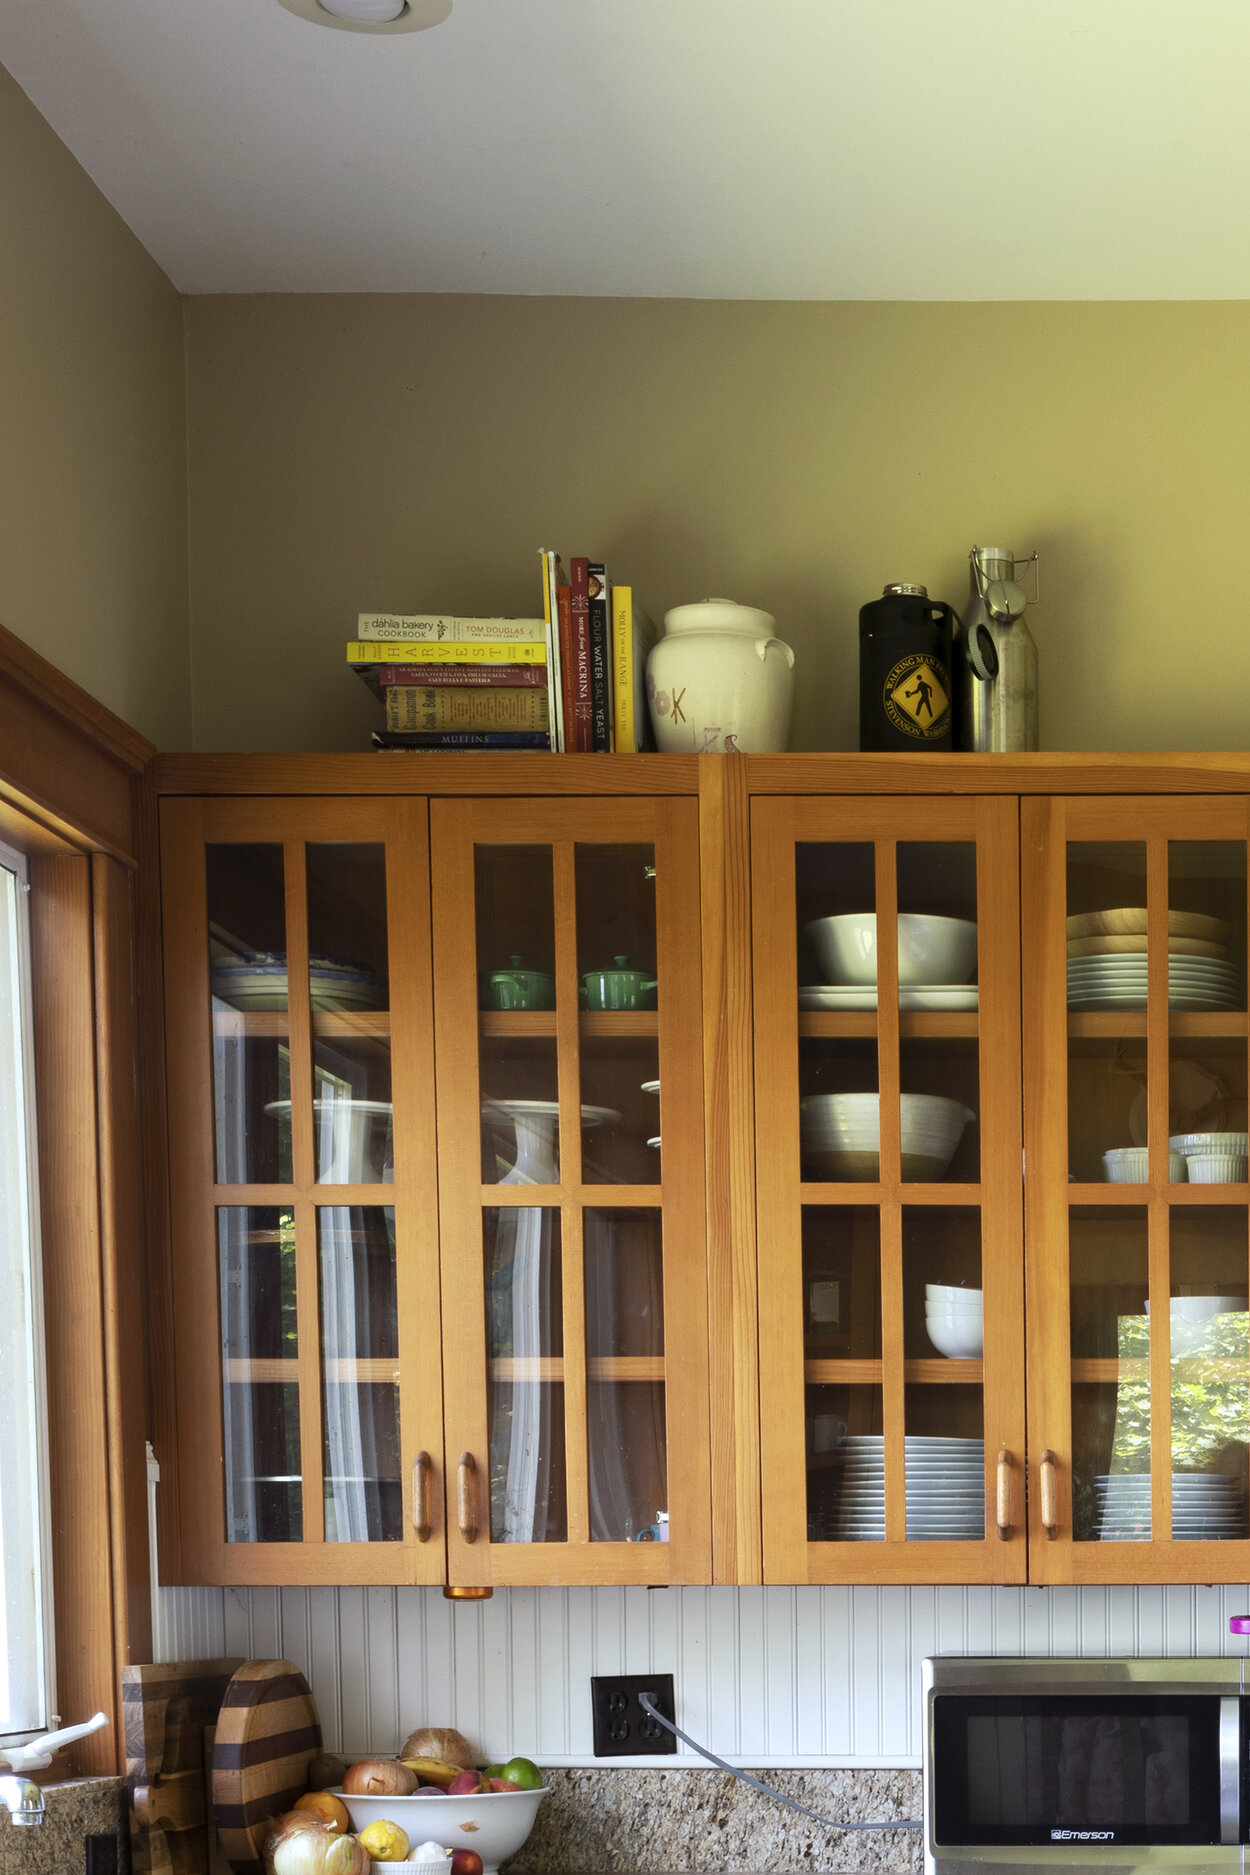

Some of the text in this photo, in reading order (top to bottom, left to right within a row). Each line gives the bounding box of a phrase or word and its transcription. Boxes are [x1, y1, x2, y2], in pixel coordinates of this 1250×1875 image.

[372, 618, 434, 632] dahlia bakery
[377, 630, 427, 638] COOKBOOK
[466, 625, 525, 635] TOM DOUGLAS
[618, 610, 626, 636] MOLLY
[387, 647, 502, 658] HARVEST
[577, 635, 585, 650] from
[578, 651, 588, 698] MACRINA
[592, 609, 605, 739] FLOUR WATER SALT YEAST
[619, 656, 627, 686] RANGE
[886, 658, 915, 690] WALKING
[916, 656, 936, 666] MAN
[403, 690, 417, 730] Companion
[422, 690, 436, 730] Cook Book
[885, 700, 920, 736] STEVENSON
[442, 735, 489, 743] MUFFINS
[1061, 1830, 1115, 1840] Emerson
